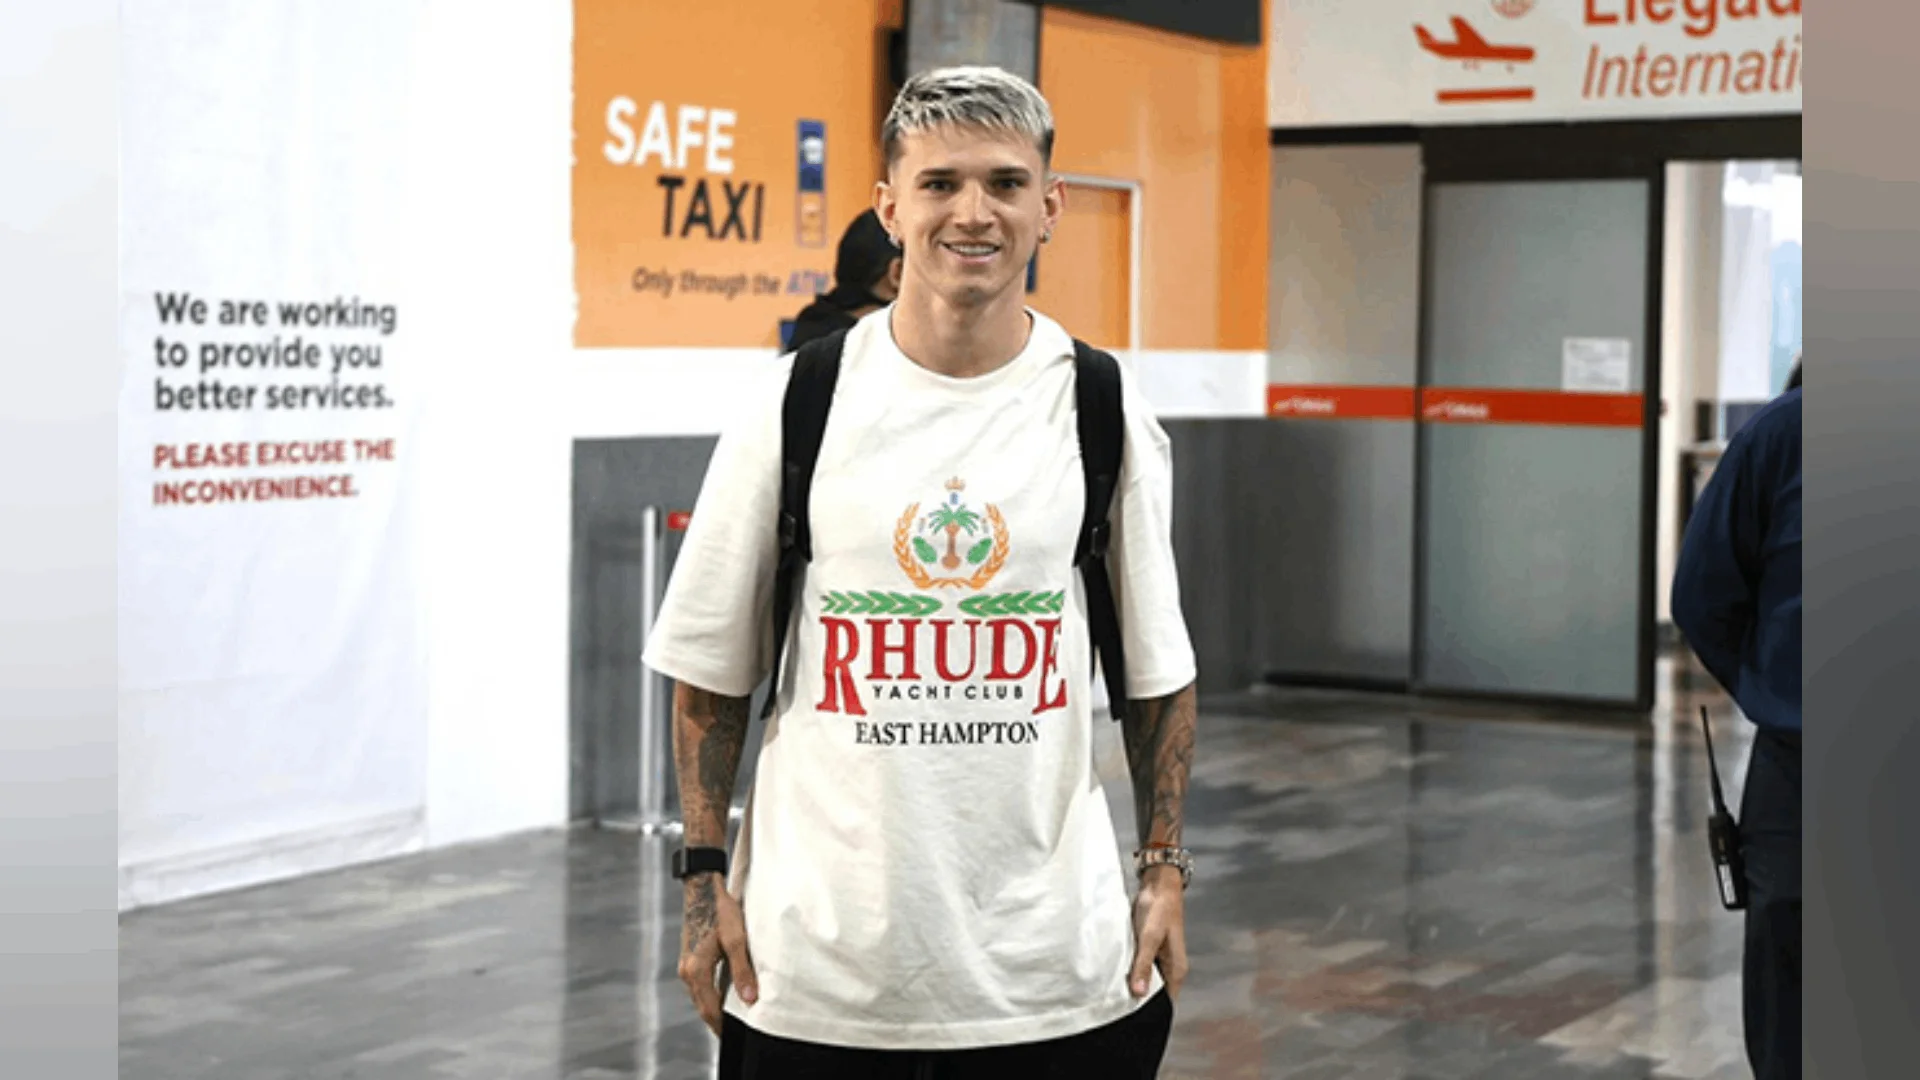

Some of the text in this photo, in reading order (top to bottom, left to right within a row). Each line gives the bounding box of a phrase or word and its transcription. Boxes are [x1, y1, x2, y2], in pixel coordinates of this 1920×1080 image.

[1583, 36, 1802, 98] Internati
[603, 96, 737, 174] SAFE
[657, 175, 764, 242] TAXI
[632, 267, 675, 297] Only
[680, 270, 748, 300] through
[753, 275, 780, 294] the
[155, 293, 396, 334] We are working
[155, 337, 381, 375] to provide you
[155, 377, 394, 410] better services.
[154, 439, 393, 469] PLEASE EXCUSE THE
[153, 475, 358, 504] INCONVENIENCE.
[815, 616, 1067, 715] RHUDE
[873, 685, 1022, 700] YACHT CLUB
[856, 722, 1039, 745] EAST HAMPTON
